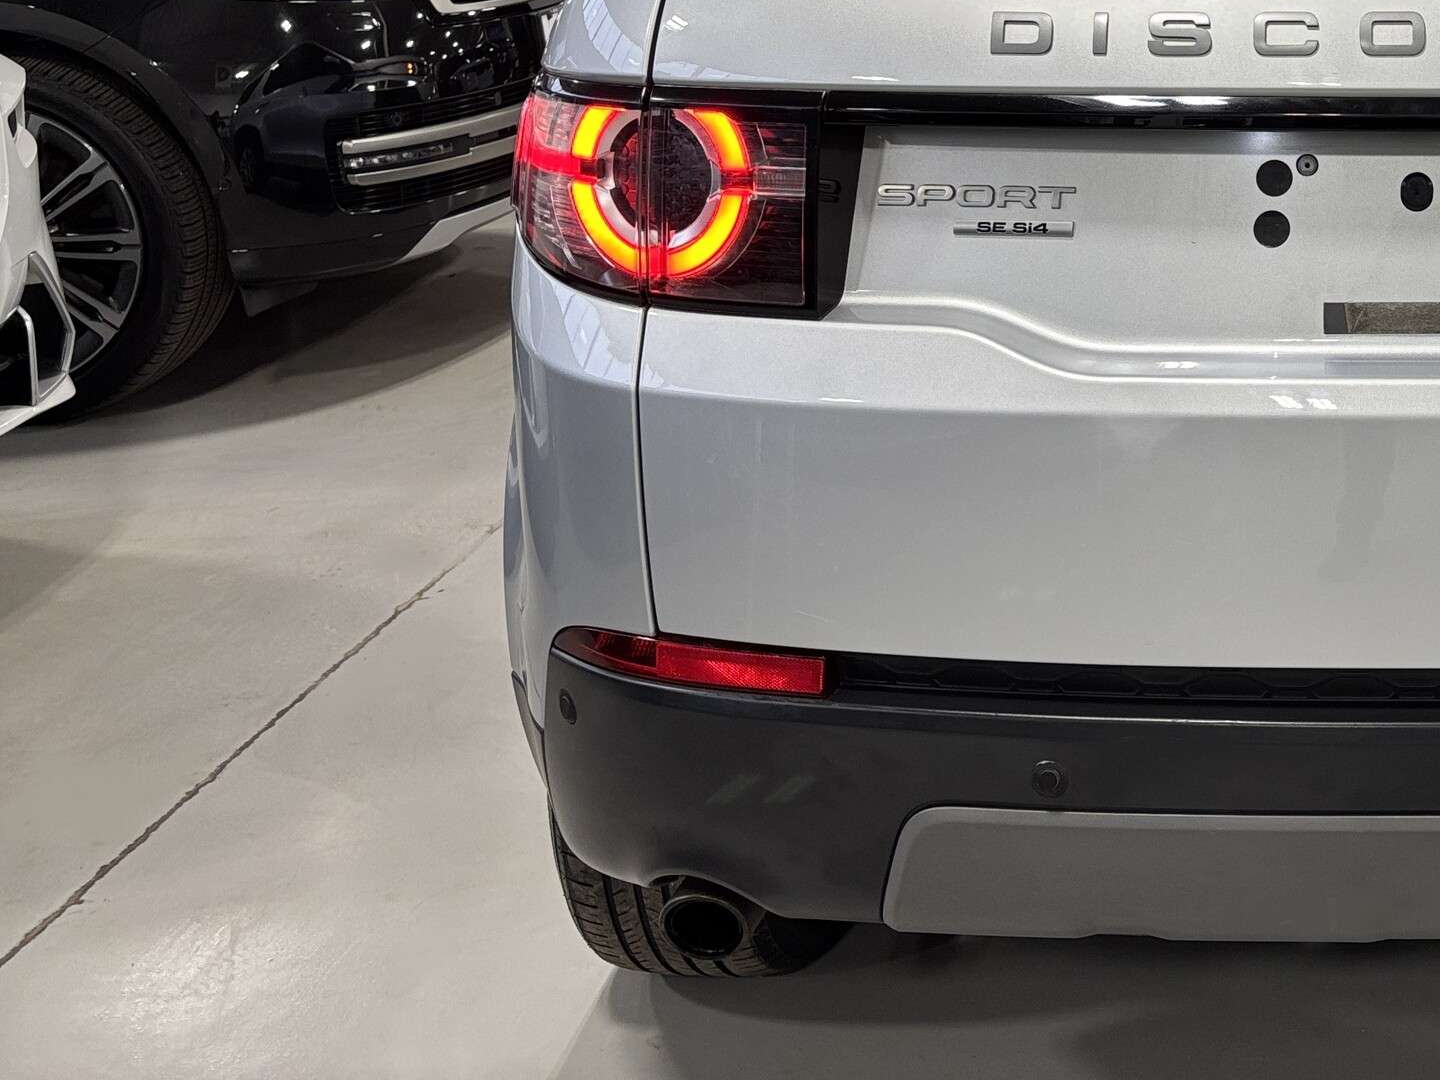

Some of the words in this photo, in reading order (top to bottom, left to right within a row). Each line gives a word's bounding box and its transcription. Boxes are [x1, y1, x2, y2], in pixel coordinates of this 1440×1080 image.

[877, 183, 1077, 210] SPORT
[976, 221, 1007, 234] SE
[1012, 222, 1049, 234] Si4
